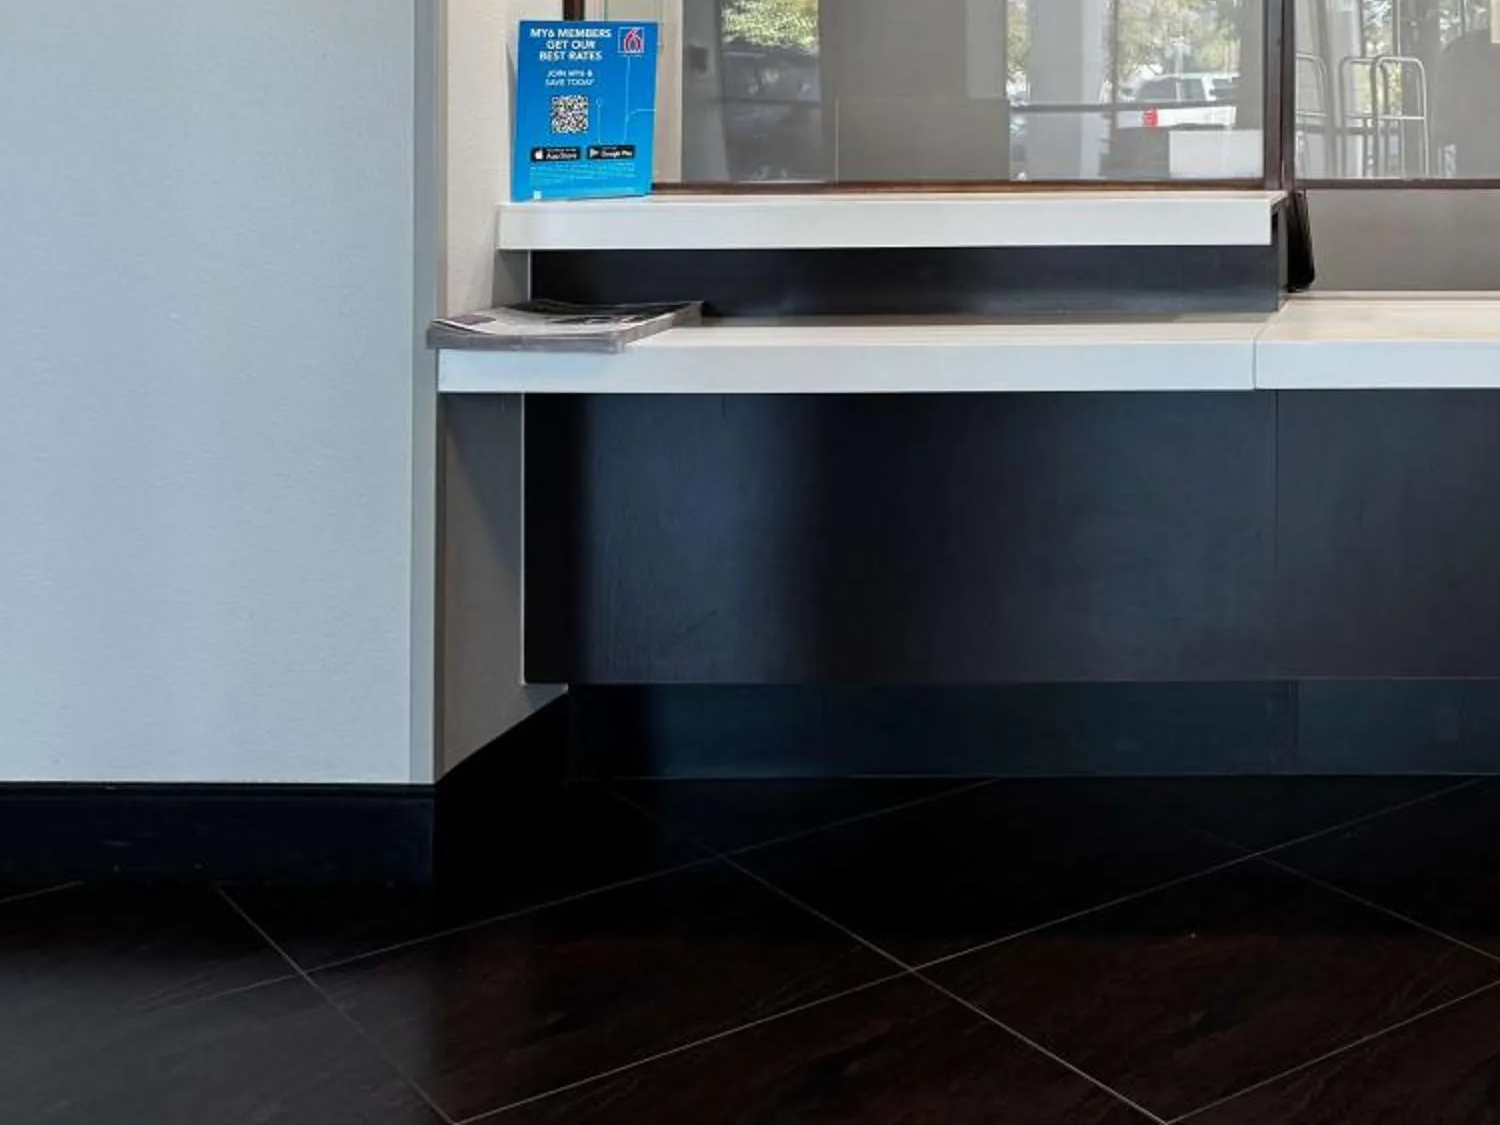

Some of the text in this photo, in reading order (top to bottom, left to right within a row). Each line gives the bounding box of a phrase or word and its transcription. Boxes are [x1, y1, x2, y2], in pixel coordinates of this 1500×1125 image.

[529, 27, 613, 38] MY6 MEMBERS
[546, 39, 597, 50] GET OUR
[539, 50, 602, 61] BEST RATES
